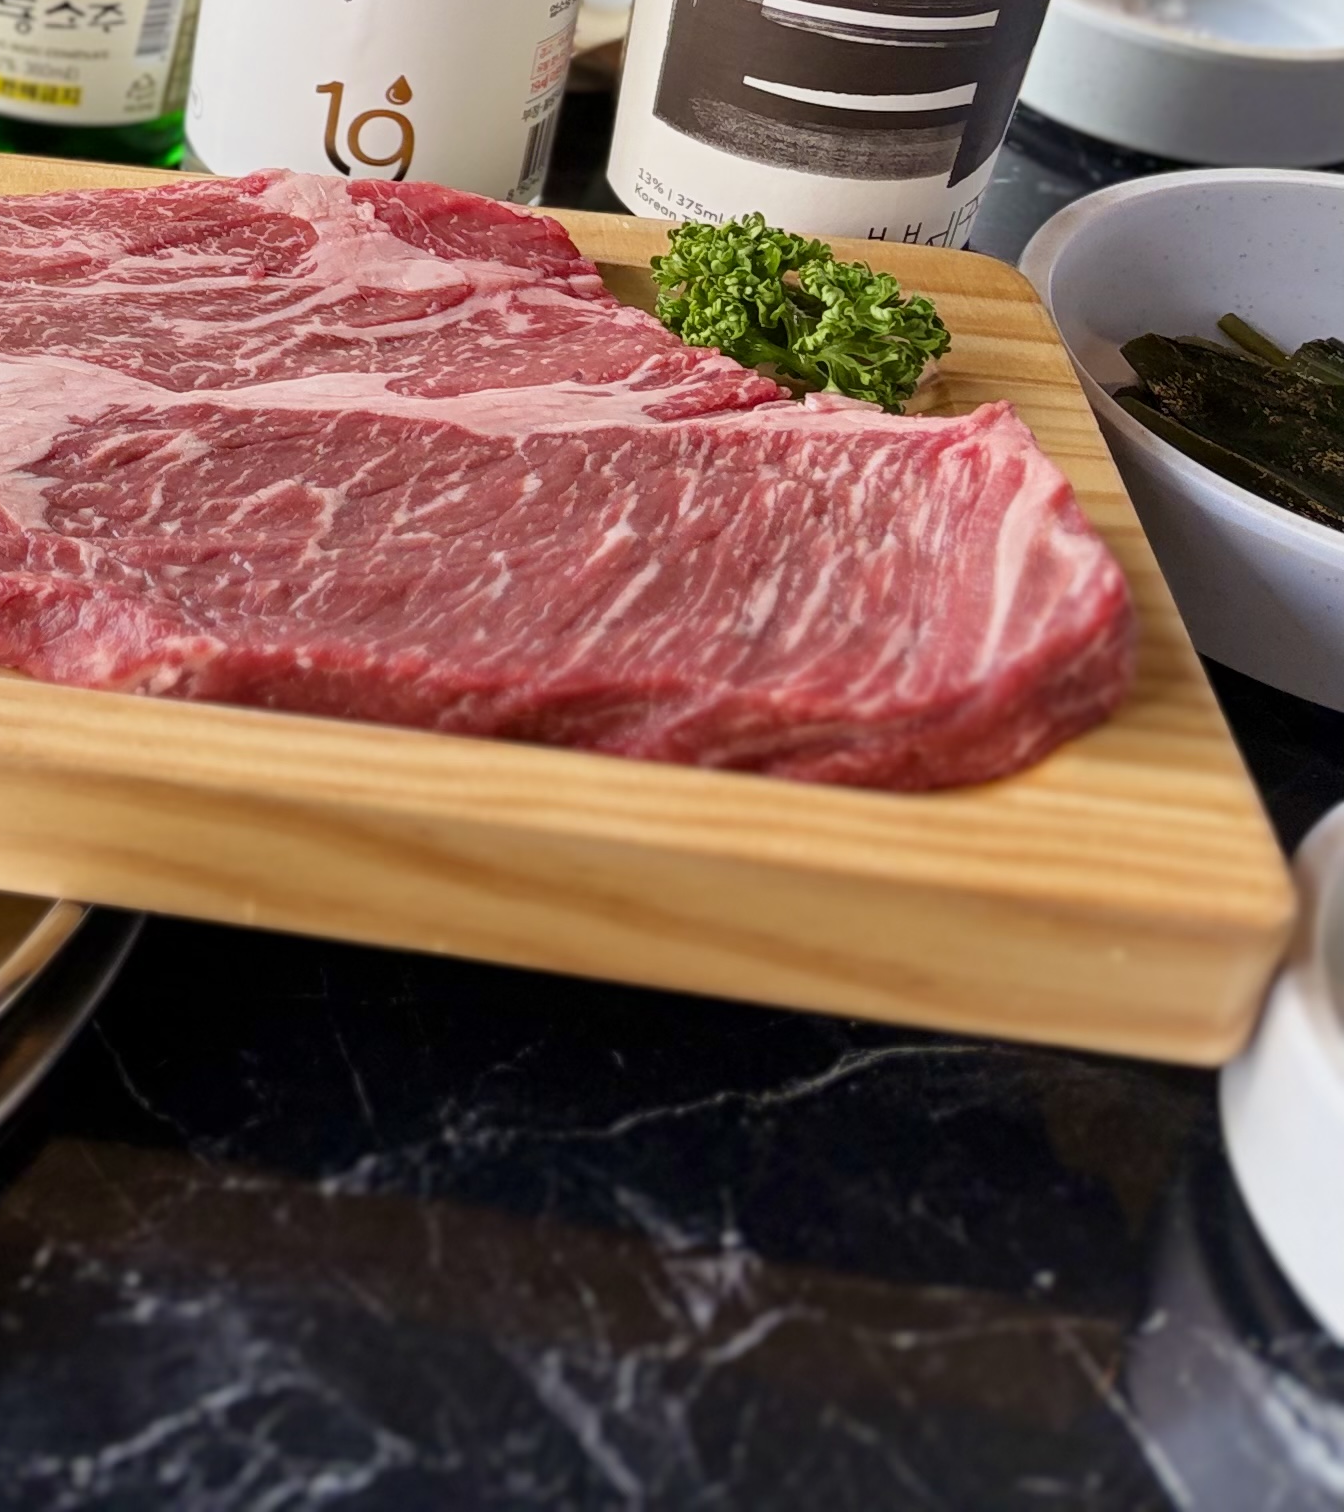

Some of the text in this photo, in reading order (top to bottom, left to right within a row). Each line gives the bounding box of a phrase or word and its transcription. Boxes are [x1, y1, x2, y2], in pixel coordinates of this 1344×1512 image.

[315, 80, 416, 182] 19
[634, 183, 678, 221] Korean
[637, 167, 665, 195] 13%
[676, 193, 724, 224] 375ml
